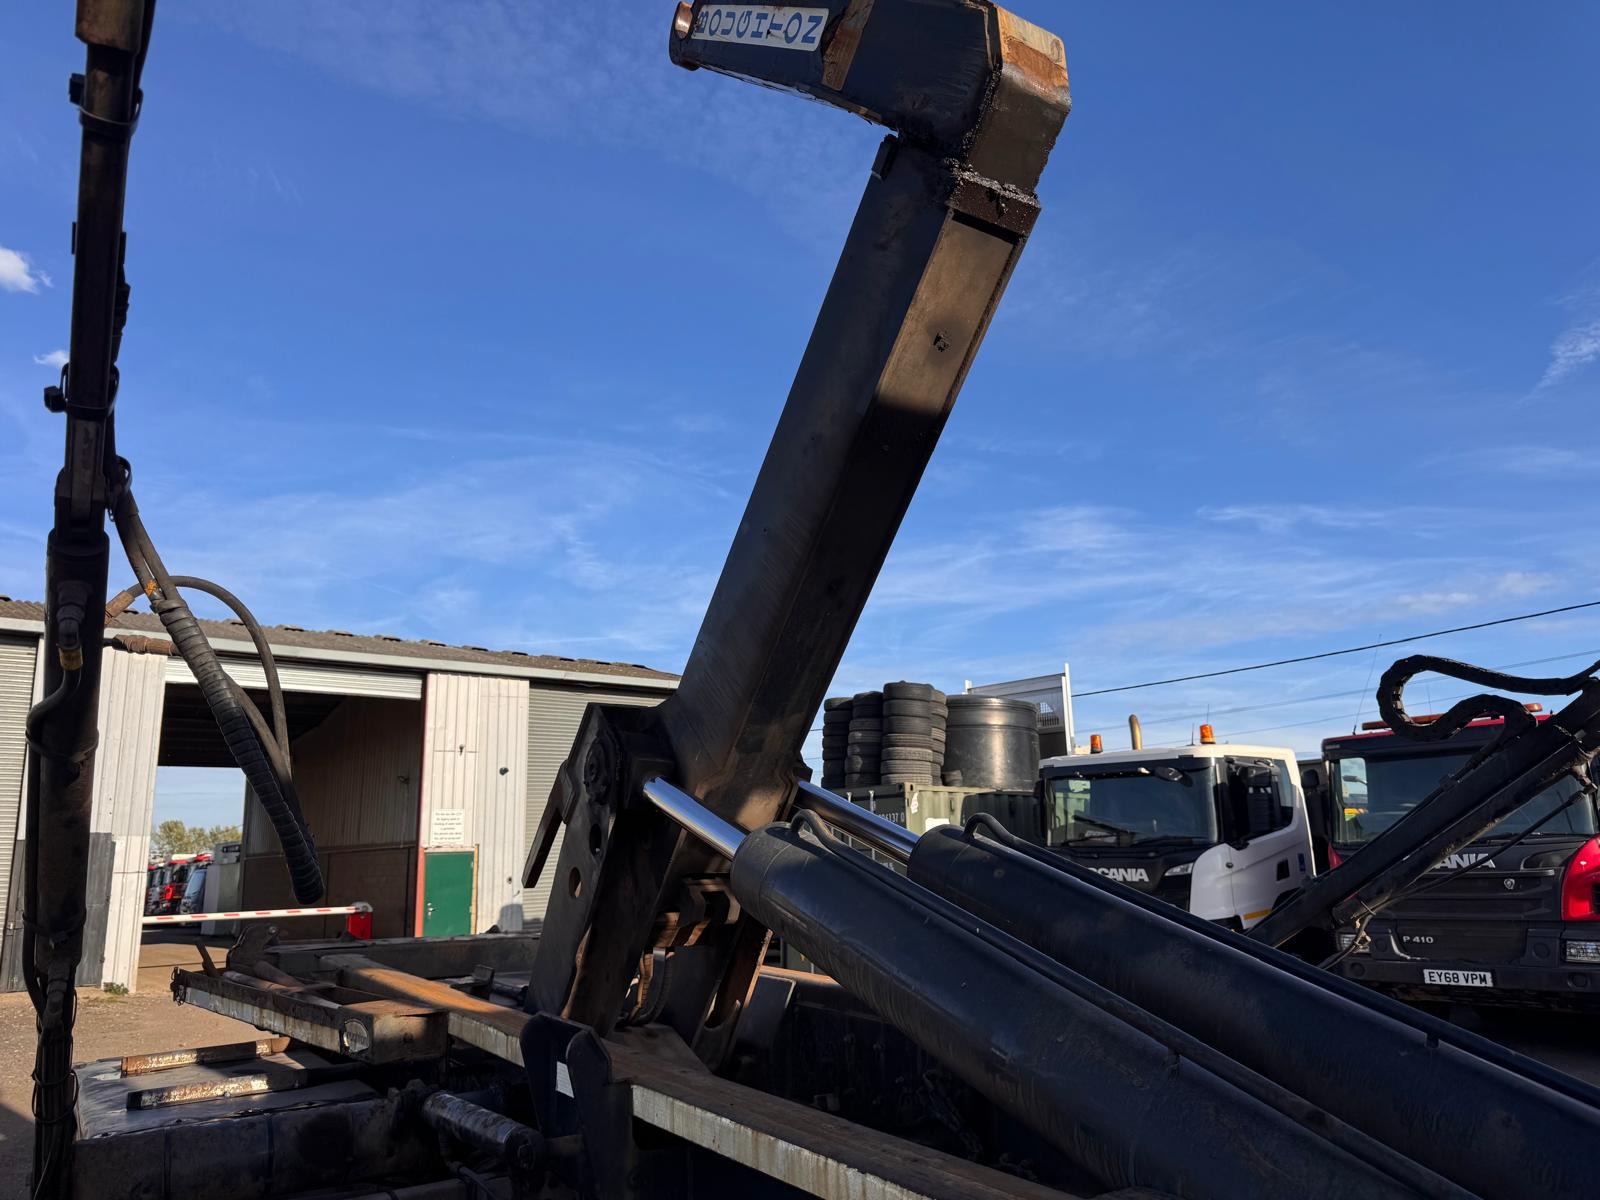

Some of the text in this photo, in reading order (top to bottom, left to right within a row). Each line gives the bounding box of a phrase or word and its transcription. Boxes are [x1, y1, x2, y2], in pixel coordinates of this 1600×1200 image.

[695, 8, 824, 45] BOUGHTON
[1432, 853, 1496, 869] ANIA
[1088, 867, 1150, 882] CANIA
[1402, 935, 1434, 944] P 410
[1428, 971, 1488, 985] EY68 VPM
